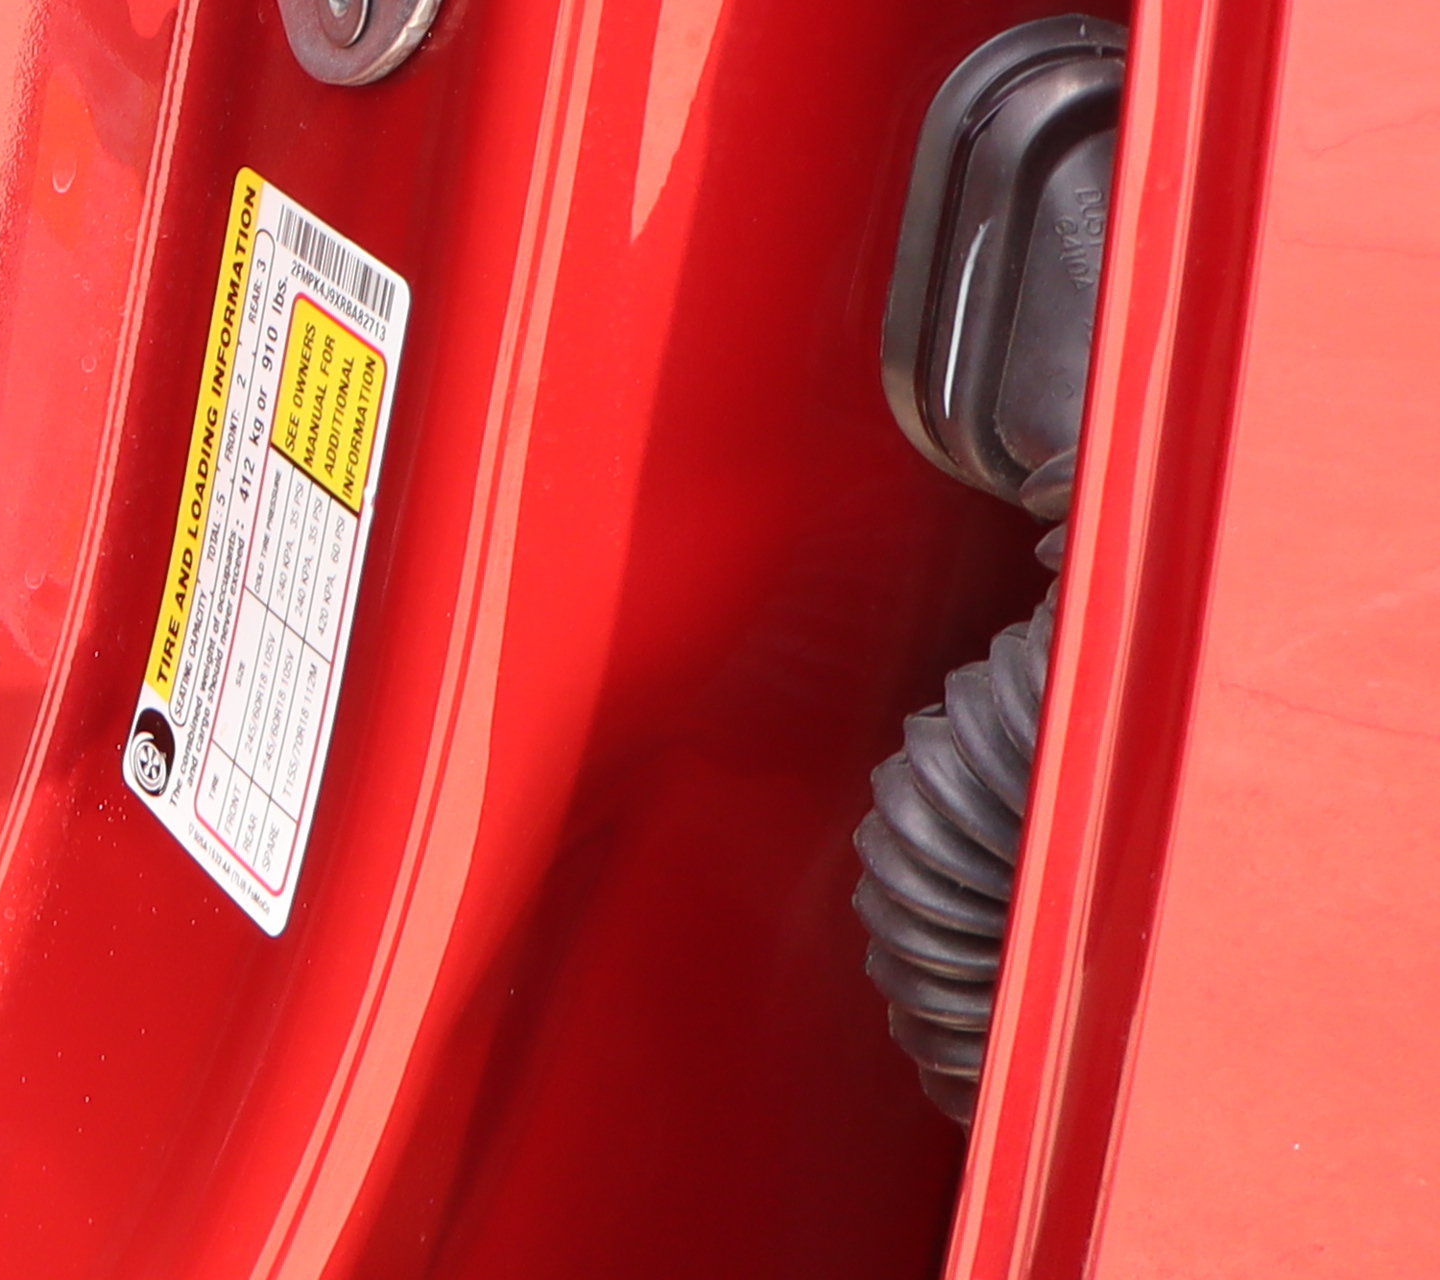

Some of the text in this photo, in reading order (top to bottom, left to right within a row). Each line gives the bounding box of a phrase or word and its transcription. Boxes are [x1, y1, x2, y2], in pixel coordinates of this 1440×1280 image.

[256, 258, 266, 272] 3
[236, 373, 246, 388] 2
[239, 277, 287, 502] 412 kg or 910 lbs.
[285, 323, 315, 452] SEE OWNERS
[303, 335, 335, 467] MANUAL FOR
[324, 358, 353, 476] ADDITIONAL
[156, 186, 255, 681] TIRE AND LOADING INFORMATION
[342, 356, 375, 498] INFORMATION
[216, 491, 225, 506] 5
[293, 481, 303, 506] PSI
[312, 497, 322, 521] PSI
[254, 471, 280, 593] COLD TIRE PRESSURE
[289, 509, 299, 529] 35
[307, 524, 318, 544] 35
[334, 515, 344, 540] PSI
[330, 543, 340, 563] 60
[276, 571, 287, 600] 240
[294, 588, 305, 616] 240
[317, 607, 328, 635] 420
[169, 530, 236, 806] The combined weight of occupants
[174, 590, 206, 717] SEATING CAPACITY
[187, 755, 198, 787] and
[195, 706, 210, 752] cargo
[207, 647, 223, 703] should
[220, 600, 232, 645] never
[224, 784, 240, 834] FRONT
[242, 813, 257, 852] REAR
[262, 822, 279, 871] SPARE
